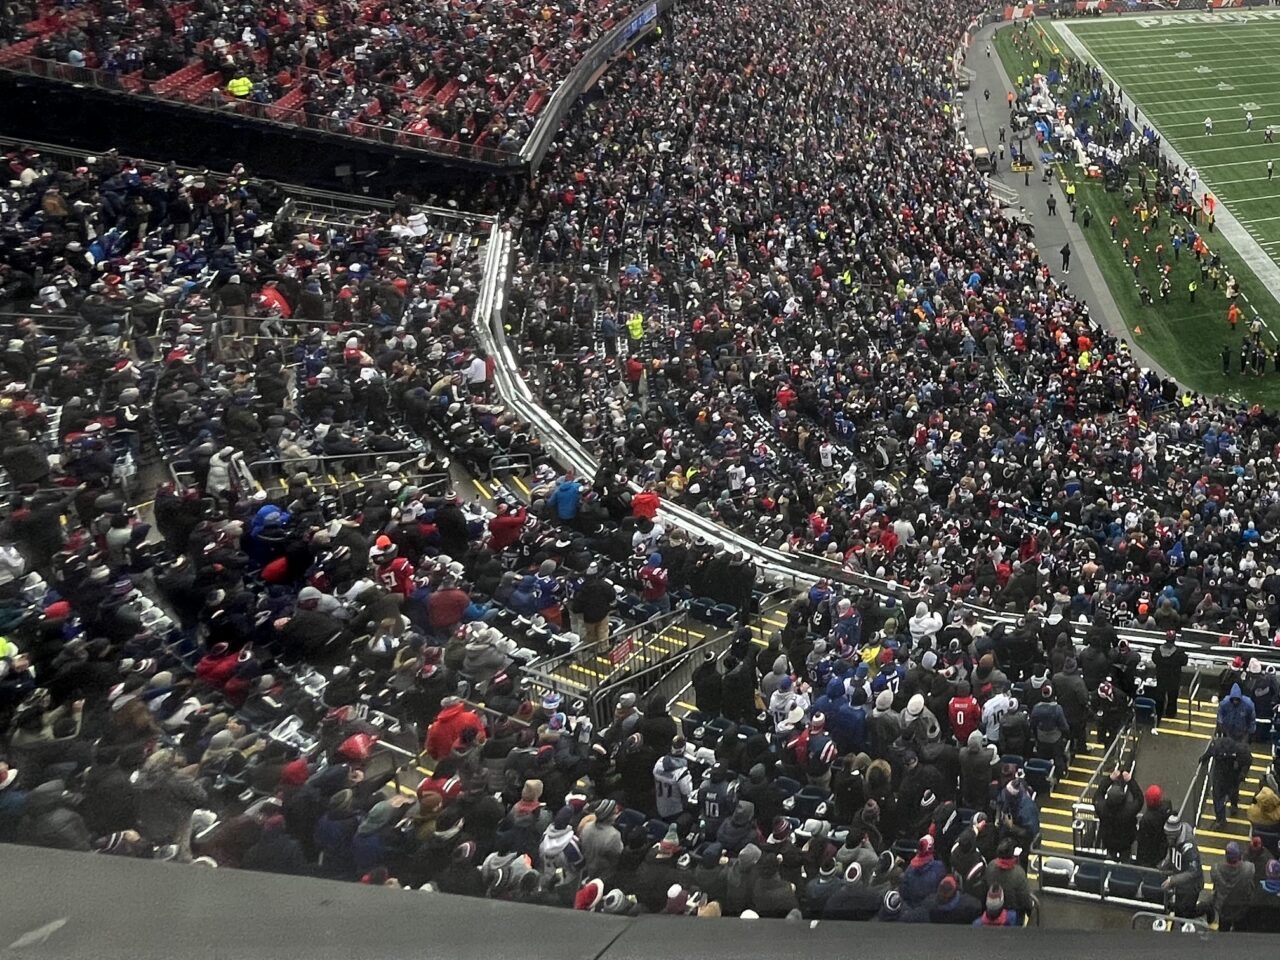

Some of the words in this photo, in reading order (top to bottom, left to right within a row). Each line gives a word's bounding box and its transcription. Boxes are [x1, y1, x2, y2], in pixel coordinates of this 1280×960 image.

[886, 677, 900, 694] 17
[956, 711, 964, 725] 0
[705, 801, 719, 818] 10
[1171, 847, 1182, 871] 10
